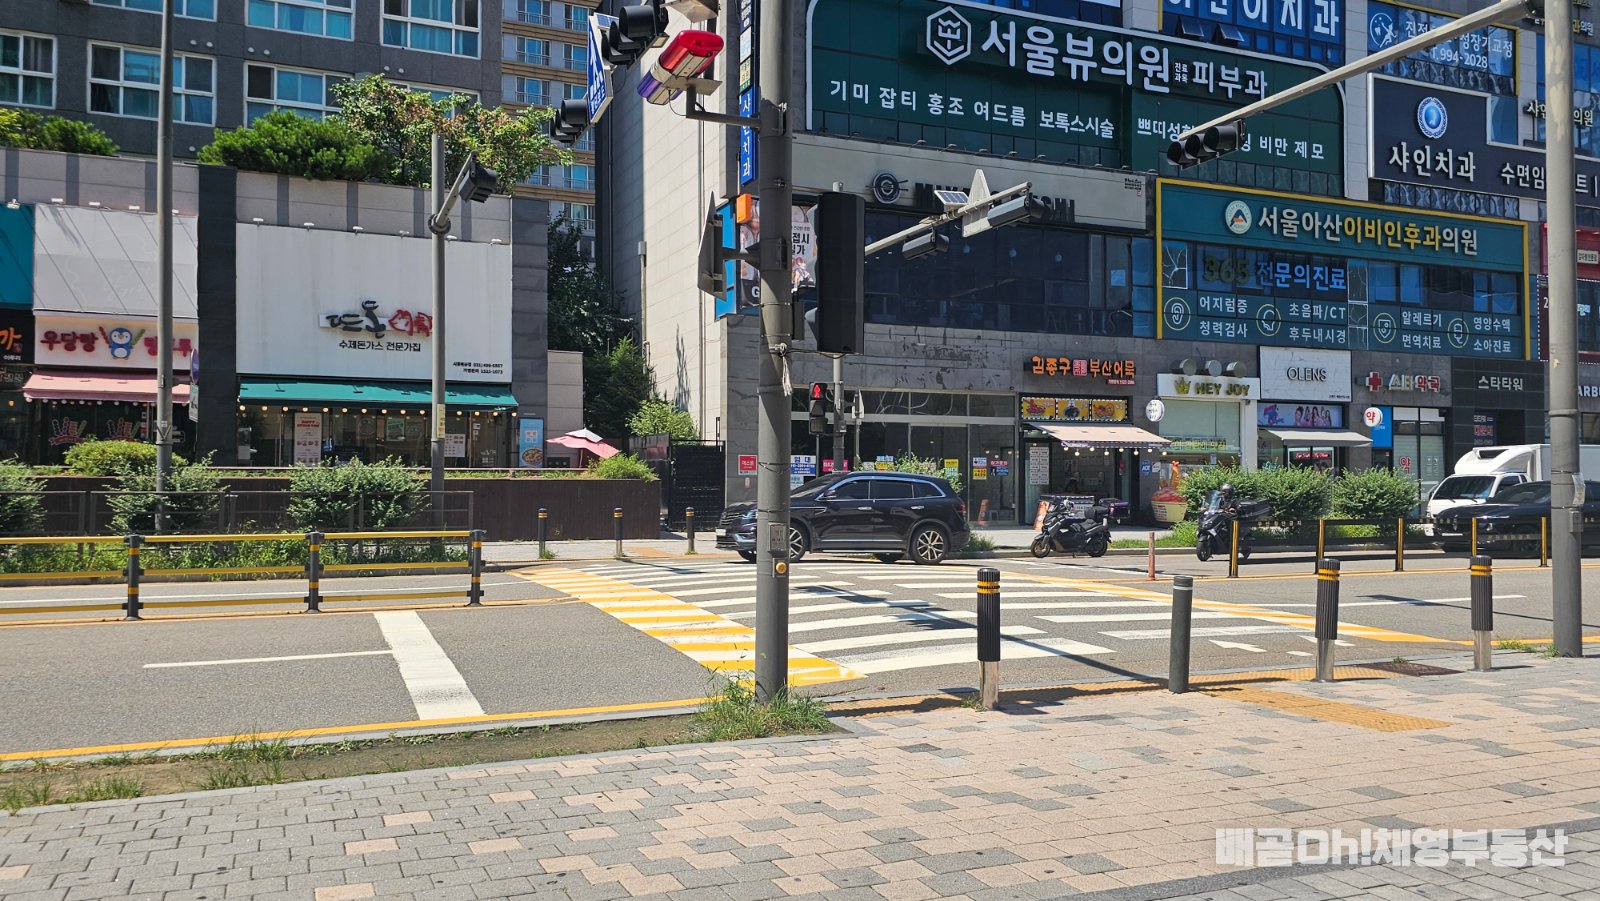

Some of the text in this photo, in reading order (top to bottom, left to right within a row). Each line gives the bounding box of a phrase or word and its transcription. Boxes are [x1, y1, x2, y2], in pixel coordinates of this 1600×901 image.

[981, 20, 1170, 94] 서울뷰의원
[1192, 61, 1267, 100] 피부과
[830, 80, 1115, 139] 기미 잡티 홍조 여드름 보톡스시술
[1259, 135, 1288, 157] 비만
[1294, 140, 1325, 160] 제모
[1389, 142, 1476, 182] 샤인치과
[1258, 206, 1478, 256] 서울아산이비인후과의원
[1203, 255, 1347, 291] 365 전문의진료
[1199, 296, 1248, 314] 어지럼증
[1289, 303, 1346, 321] 초음파/CT
[1402, 311, 1442, 328] 알레르기
[1473, 316, 1511, 332] 영양수액
[1199, 321, 1248, 338] 청력검사
[1289, 326, 1346, 344] 후두내시경
[339, 340, 421, 352] 수제돈가스 전문가집
[1402, 335, 1441, 349] 면역치료
[1473, 339, 1511, 353] 소아진료
[1032, 355, 1070, 376] 김종구
[1089, 358, 1135, 379] 부산어묵
[1287, 367, 1327, 382] OLENS
[1195, 382, 1250, 396] HEY JOY
[1389, 373, 1441, 393] 스타약국
[1478, 375, 1524, 391] 스타타워
[1578, 385, 1600, 397] ARB
[1366, 411, 1376, 423] 약
[1400, 457, 1411, 474] 약
